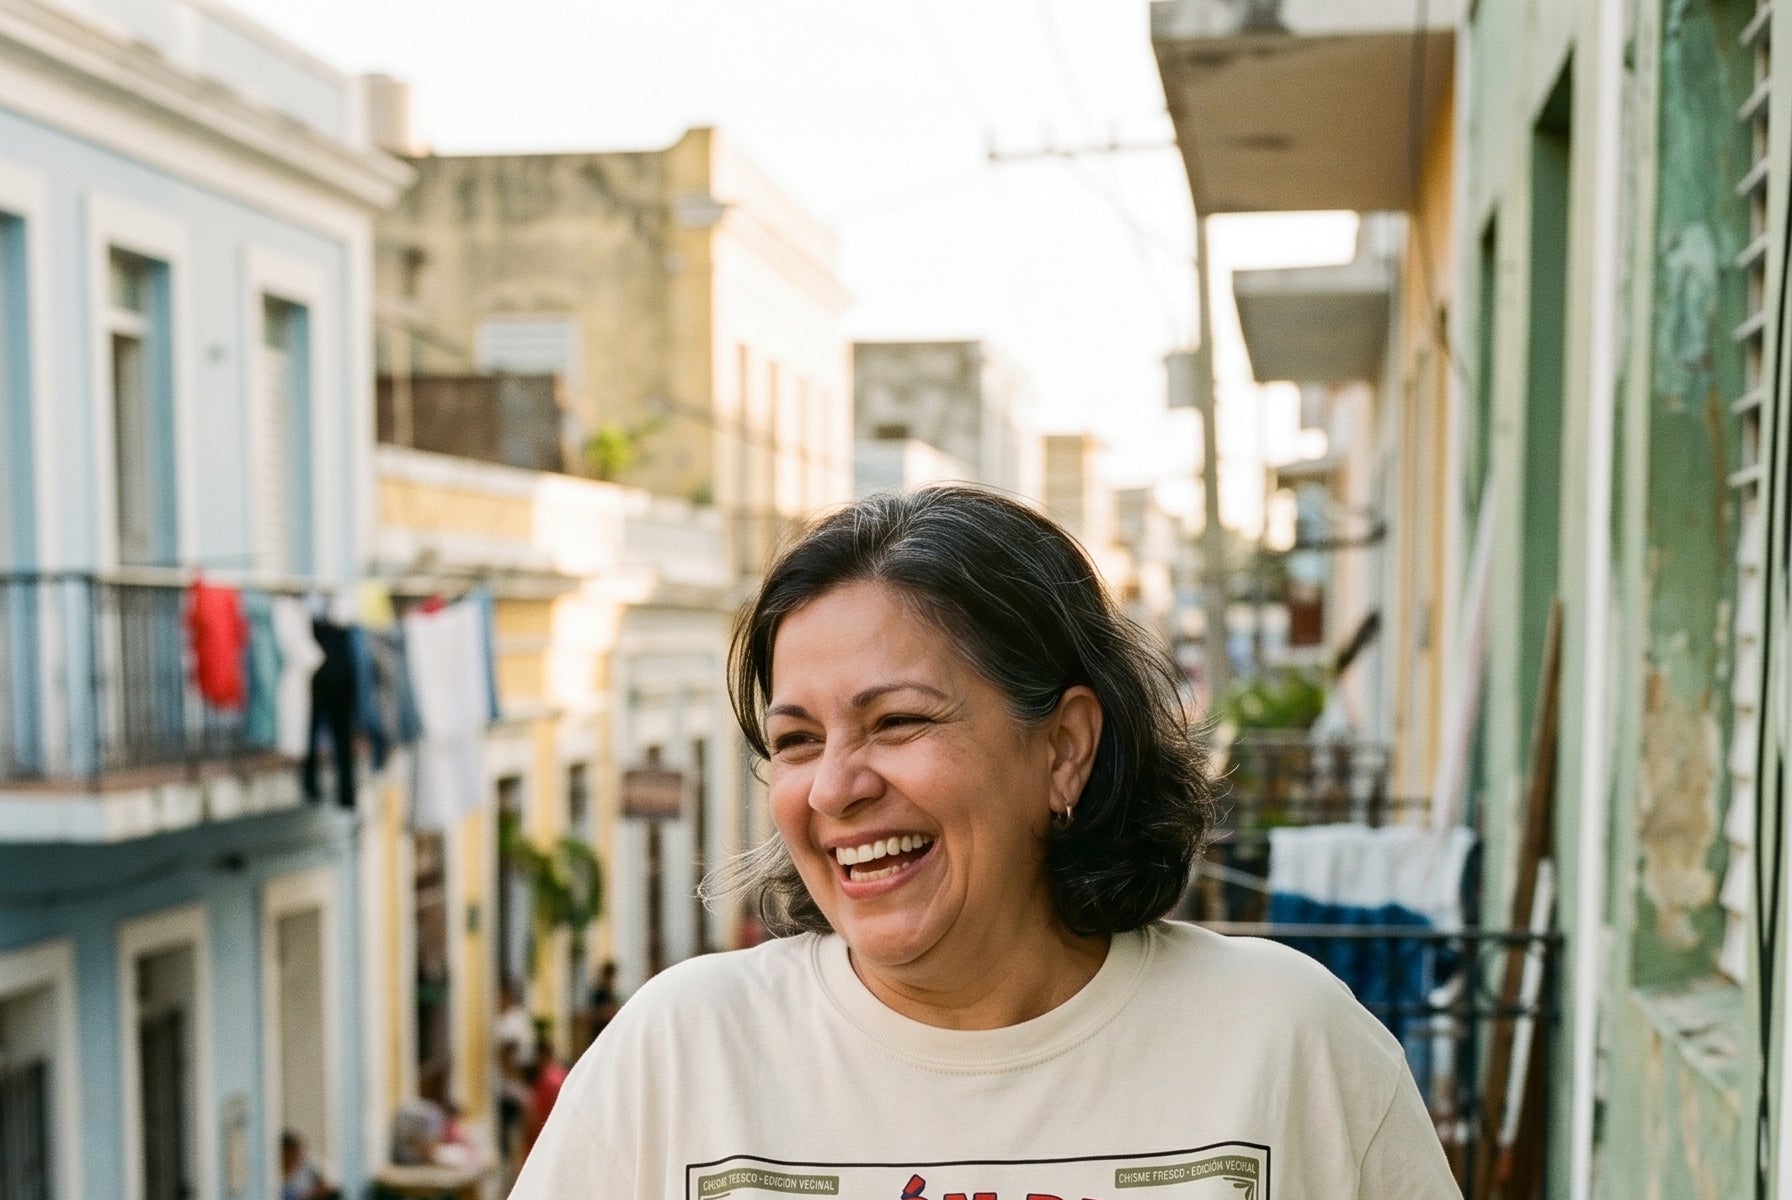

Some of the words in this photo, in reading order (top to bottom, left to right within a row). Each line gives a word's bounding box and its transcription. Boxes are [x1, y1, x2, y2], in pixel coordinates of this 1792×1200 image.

[1118, 1172, 1151, 1184] CHISME
[1152, 1168, 1185, 1181] FRESCO
[799, 1178, 835, 1191] VECINAL
